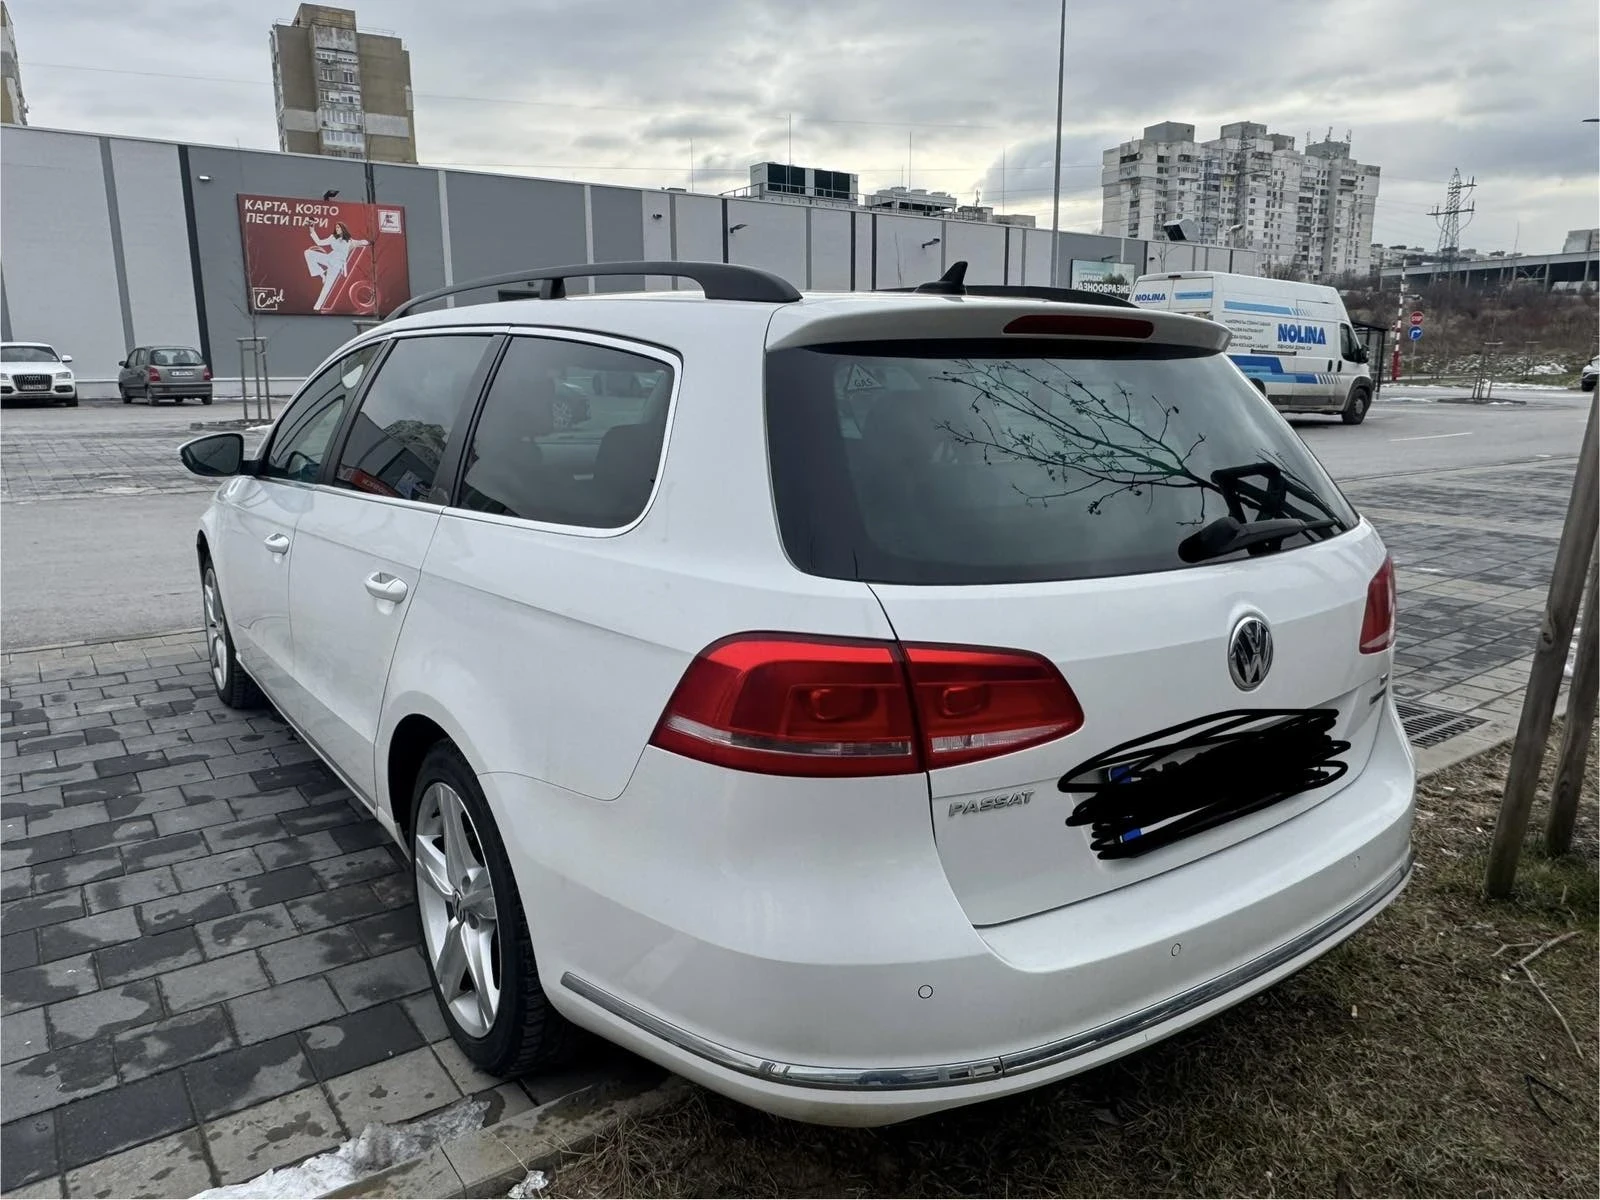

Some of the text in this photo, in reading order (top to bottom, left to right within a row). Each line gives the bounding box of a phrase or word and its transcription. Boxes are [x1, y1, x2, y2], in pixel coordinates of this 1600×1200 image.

[245, 199, 339, 216] КАРТА, КОЯТО
[246, 213, 290, 225] ПЕСТИ
[257, 288, 285, 307] Card
[1135, 293, 1166, 302] NOLINA
[1277, 323, 1327, 345] NOLINA
[948, 790, 1035, 818] PASSAT
